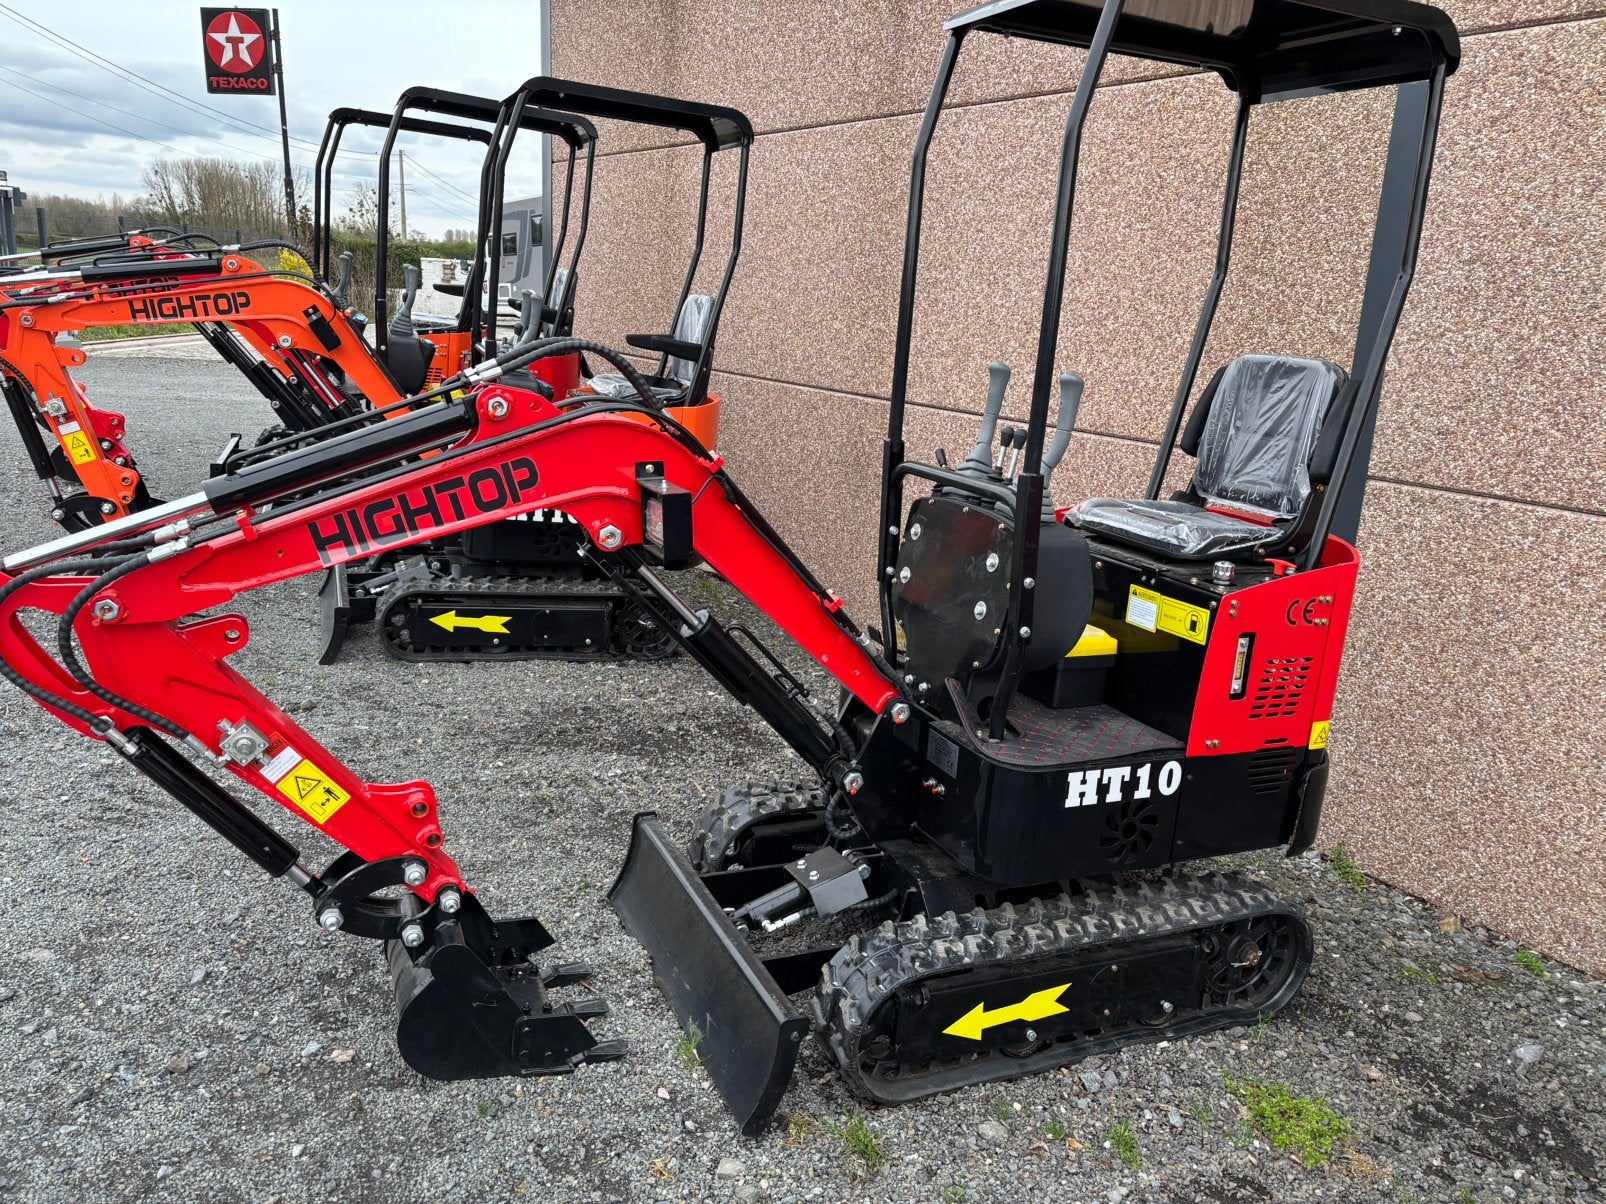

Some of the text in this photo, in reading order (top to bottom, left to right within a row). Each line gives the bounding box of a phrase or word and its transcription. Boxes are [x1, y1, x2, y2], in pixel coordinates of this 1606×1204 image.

[209, 77, 269, 90] TEXACO
[128, 291, 251, 322] HIGHTOP
[307, 456, 539, 566] HIGHTOP
[1286, 599, 1314, 625] CE
[1064, 760, 1182, 808] HT10
